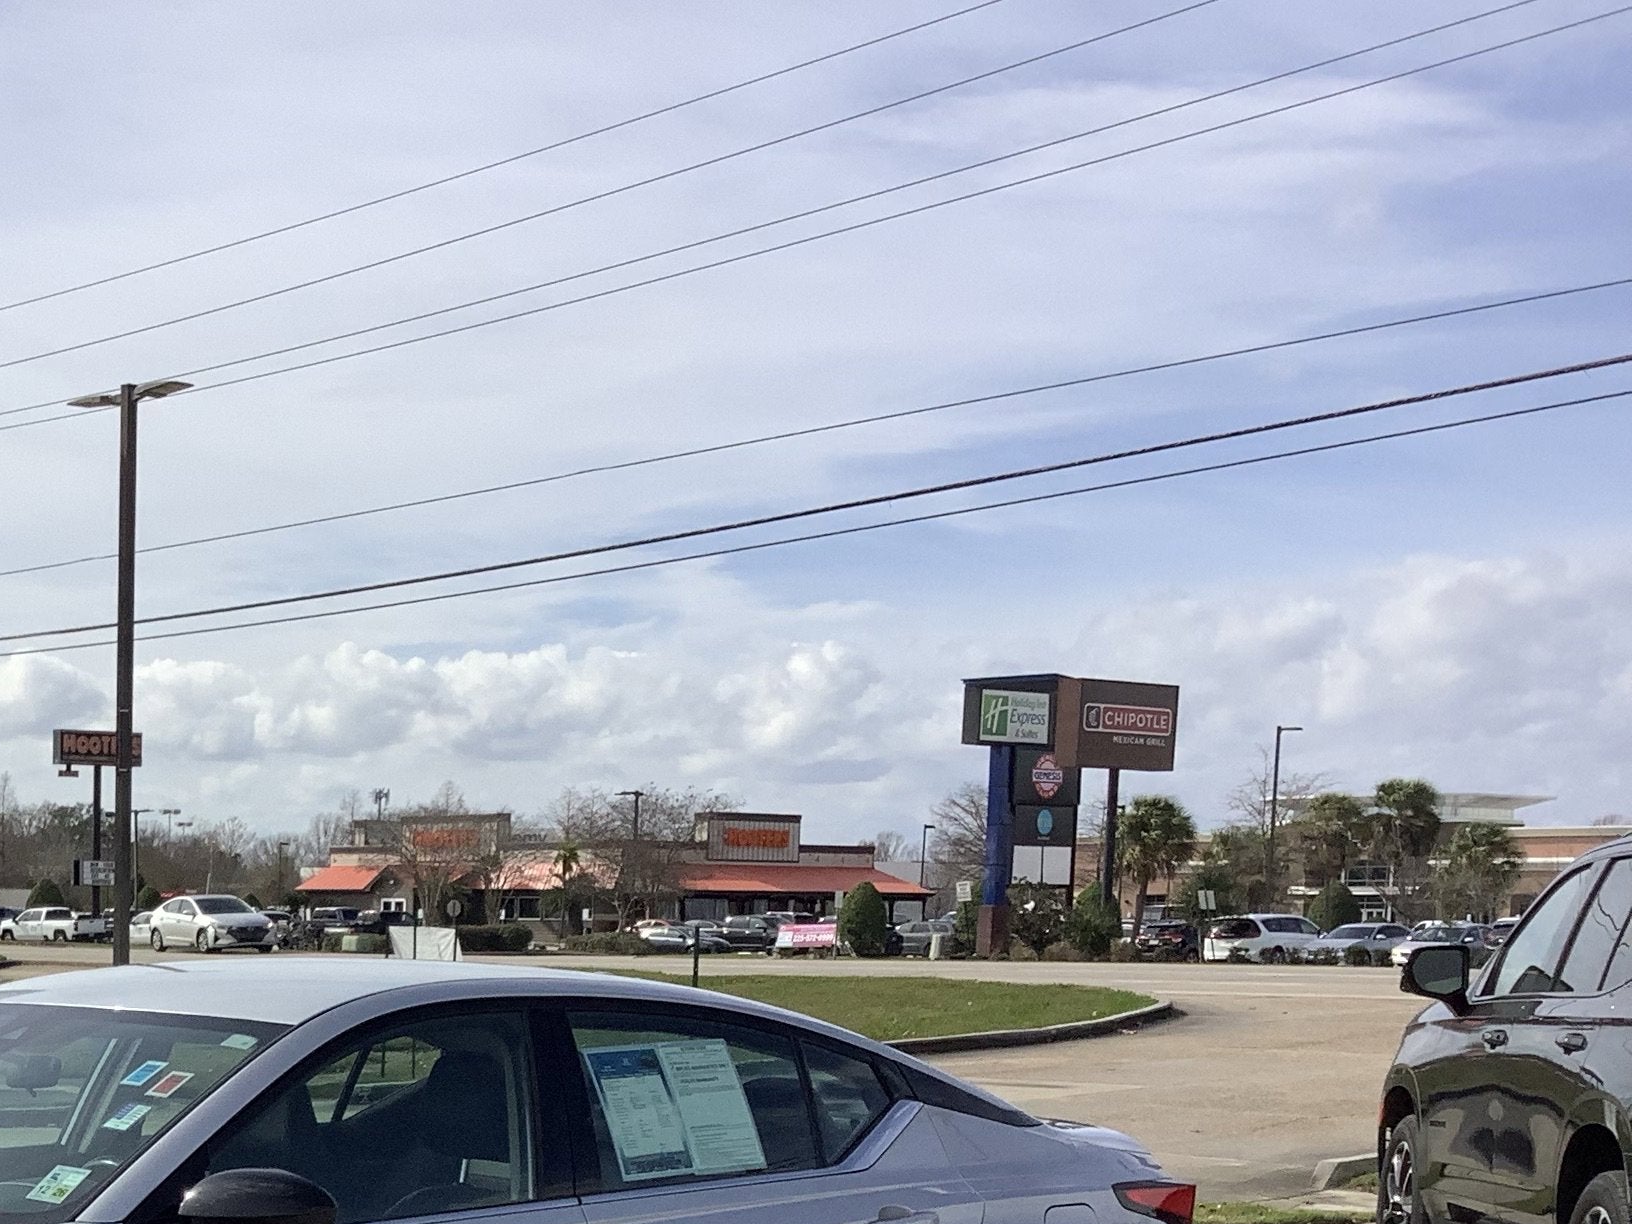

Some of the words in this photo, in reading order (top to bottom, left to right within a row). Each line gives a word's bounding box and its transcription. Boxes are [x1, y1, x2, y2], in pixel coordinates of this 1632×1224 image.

[1010, 708, 1046, 727] Express
[1104, 711, 1168, 729] CHIPOTLE
[1112, 735, 1145, 746] MEXICAN
[1146, 737, 1166, 747] GRILL
